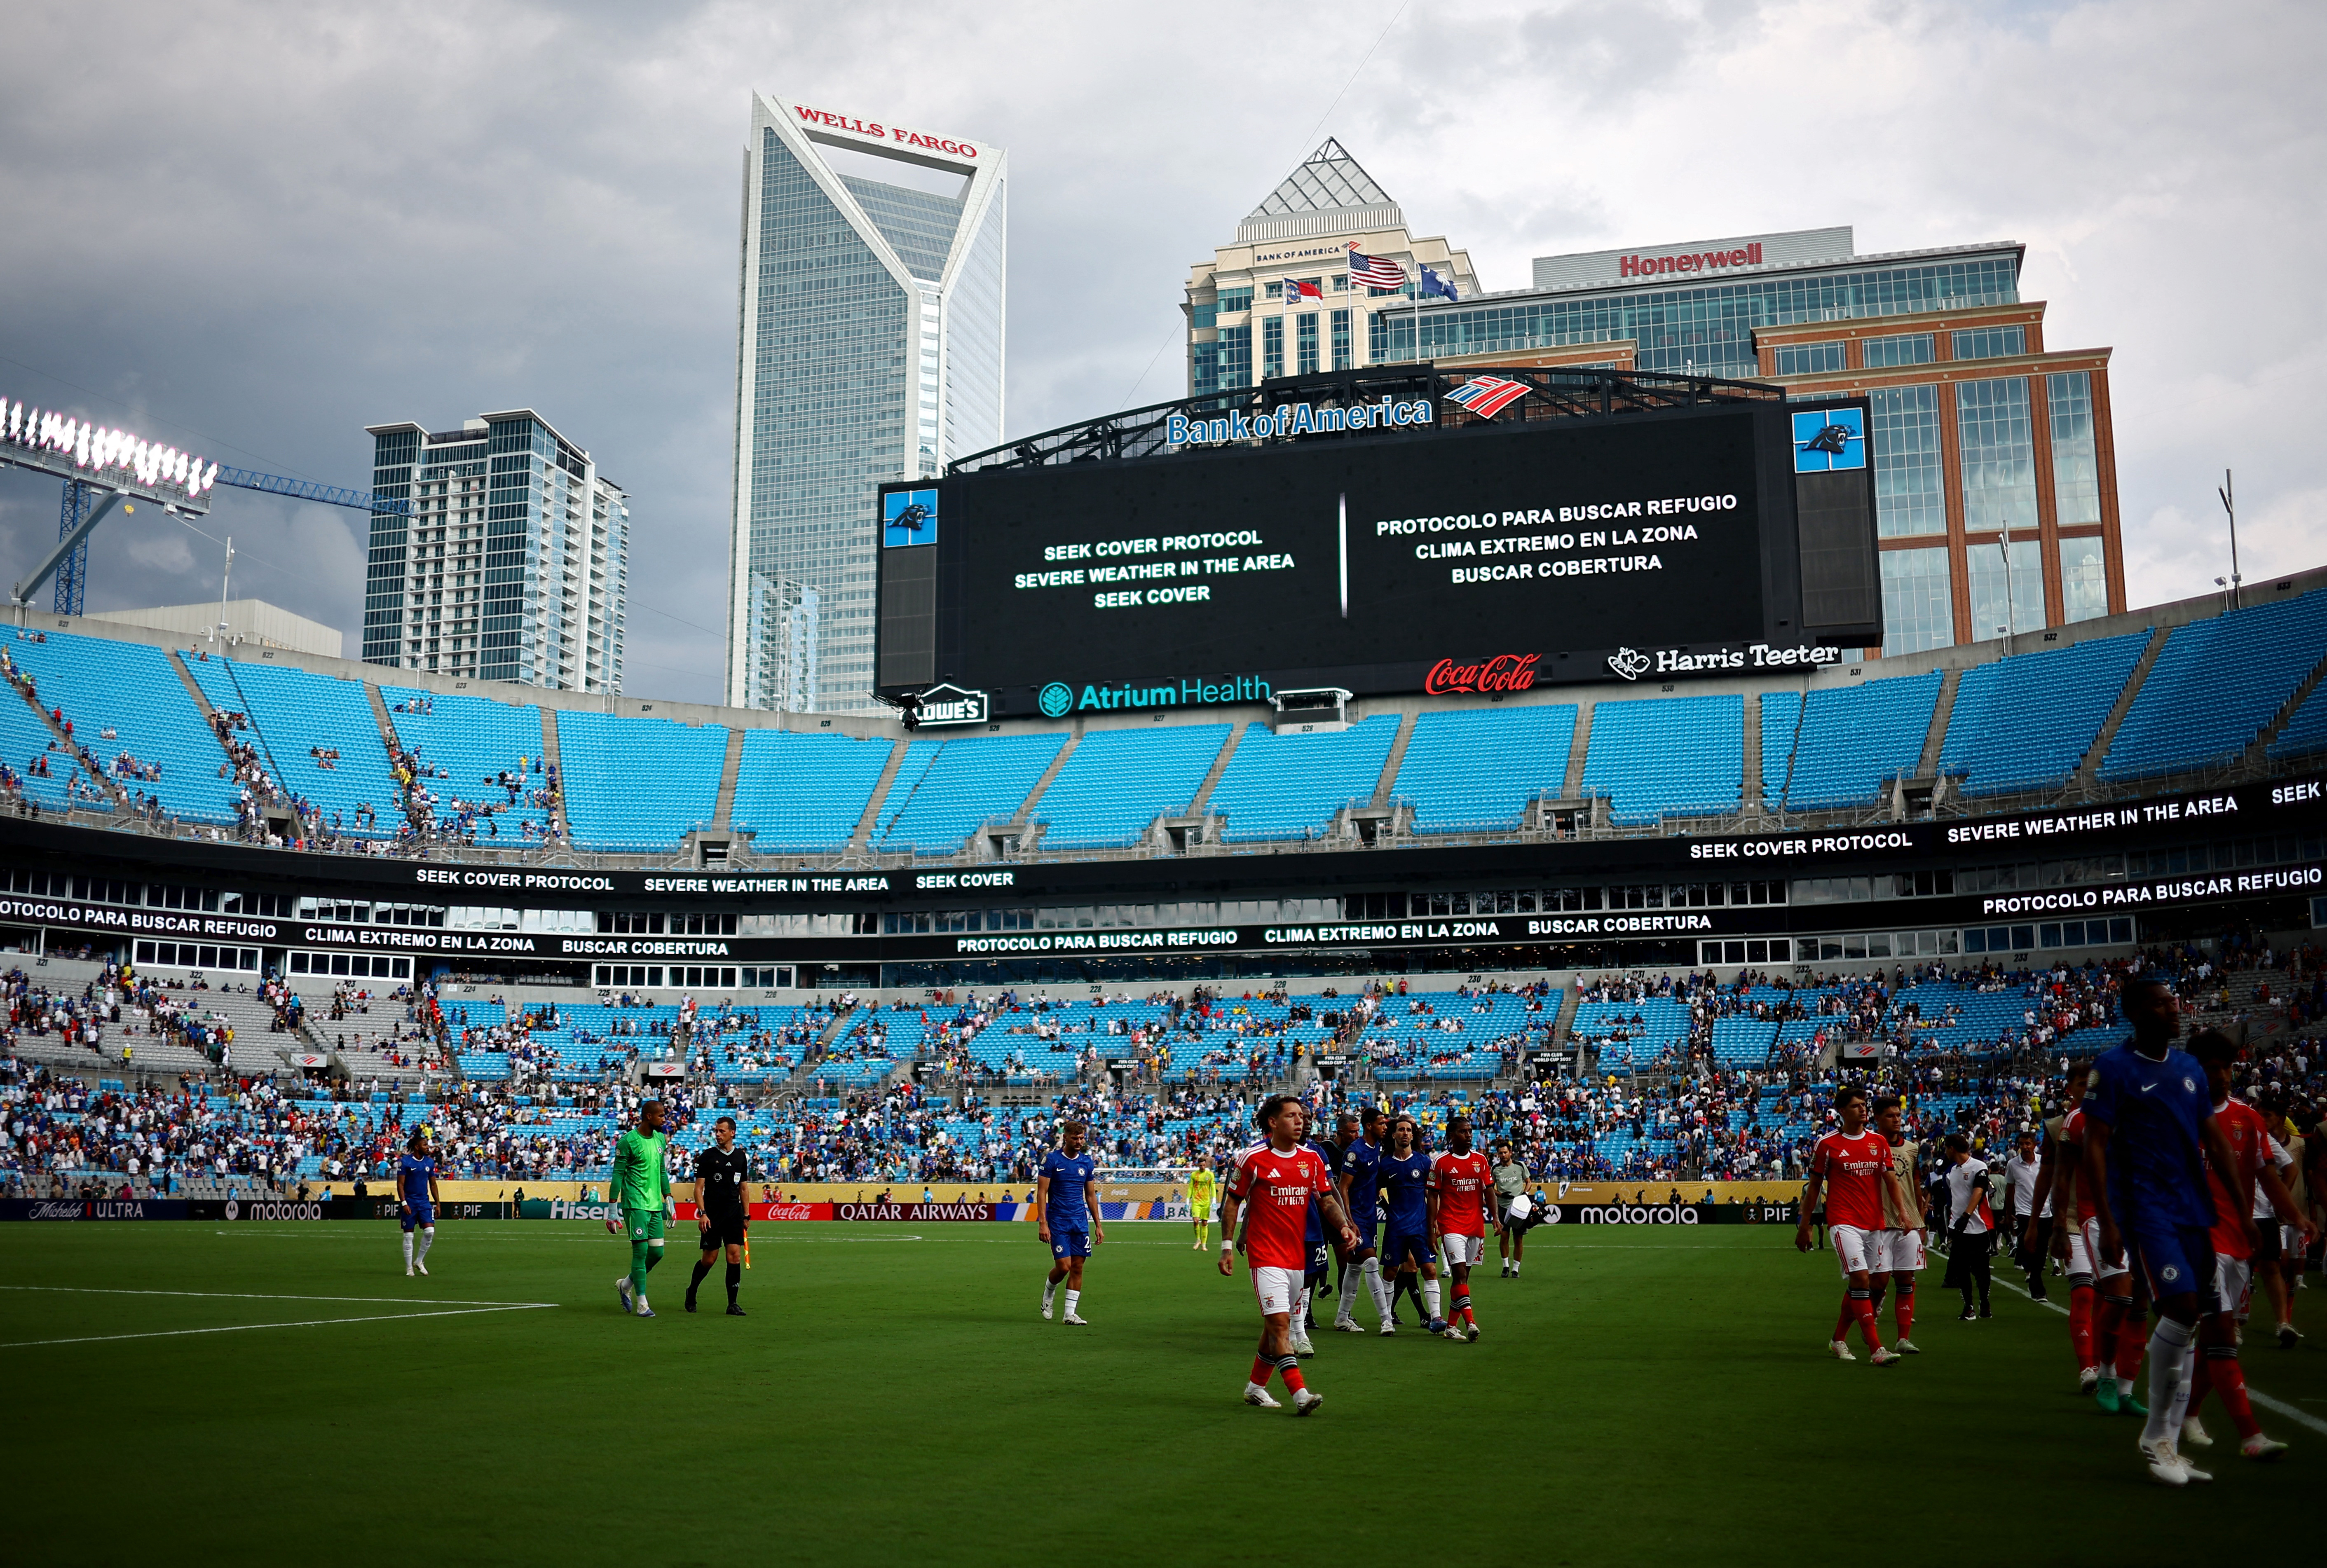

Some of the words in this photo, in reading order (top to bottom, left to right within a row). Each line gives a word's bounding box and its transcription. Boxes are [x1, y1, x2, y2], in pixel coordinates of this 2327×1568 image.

[795, 105, 886, 137] WELLS
[893, 128, 977, 157] FARGO
[1257, 253, 1281, 262] BANK
[1298, 246, 1340, 256] AMERICA
[1620, 242, 1762, 276] Honeywell
[1166, 410, 1250, 445] Bank
[1252, 404, 1289, 438] of
[1291, 395, 1432, 435] America
[1377, 513, 1497, 536] PROTOCOLO
[1502, 508, 1555, 526] PARA
[1560, 502, 1642, 522] BUSCAR
[1647, 494, 1736, 515] REFUGIO
[1045, 543, 1091, 561] SEEK
[1096, 538, 1158, 556] COVER
[1162, 530, 1263, 551] PROTOCOL
[1416, 541, 1476, 559] CLIMA
[1481, 534, 1574, 555] EXTREMO
[1580, 531, 1605, 548] EN
[1612, 529, 1638, 545] LA
[1642, 525, 1698, 543] ZONA
[1015, 570, 1084, 588] SEVERE
[1089, 563, 1176, 582] WEATHER
[1181, 561, 1198, 576] IN
[1203, 557, 1239, 573] THE
[1243, 554, 1295, 571] AREA
[1452, 564, 1533, 583] BUSCAR
[1538, 555, 1662, 577] COBERTURA
[1095, 591, 1142, 608] SEEK
[1147, 586, 1210, 604] COVER
[1656, 648, 1744, 672] Harris
[1749, 644, 1839, 666] Teeter
[1424, 653, 1542, 695] Coca-Cola
[1078, 682, 1176, 710] Atrium
[1181, 674, 1271, 704] Health
[914, 699, 978, 721] LOWE'S
[2272, 782, 2321, 804] SEEK
[1948, 822, 2020, 843] SEVERE
[2025, 812, 2116, 835] WEATHER
[2121, 809, 2138, 825] IN
[2143, 803, 2180, 821] THE
[2185, 796, 2238, 817] AREA
[1691, 843, 1738, 858] SEEK
[1743, 840, 1807, 856] COVER
[1812, 833, 1912, 852] PROTOCOL
[417, 869, 459, 884] SEEK
[464, 872, 521, 887] COVER
[525, 875, 614, 890] PROTOCOL
[644, 878, 708, 892] SEVERE
[712, 879, 788, 892] WEATHER
[792, 879, 807, 892] IN
[811, 879, 841, 891] THE
[845, 878, 888, 891] AREA
[916, 875, 956, 889] SEEK
[960, 873, 1013, 887] COVER
[1984, 892, 2097, 914] PROTOCOLO
[2103, 887, 2152, 905] PARA
[2156, 878, 2233, 899] BUSCAR
[2238, 868, 2322, 891] REFUGIO
[85, 909, 127, 926] PARA
[131, 914, 199, 932] BUSCAR
[205, 920, 276, 938] REFUGIO
[1265, 929, 1315, 943] CLIMA
[1319, 926, 1397, 941] EXTREMO
[1401, 925, 1423, 938] EN
[1428, 924, 1450, 937] LA
[1453, 922, 1499, 936] ZONA
[1529, 919, 1599, 934] BUSCAR
[1604, 915, 1711, 931] COBERTURA
[305, 928, 356, 943] CLIMA
[360, 931, 436, 947] EXTREMO
[441, 936, 462, 948] EN
[466, 937, 487, 949] LA
[490, 938, 534, 951] ZONA
[562, 940, 627, 954] BUSCAR
[631, 942, 728, 955] COBERTURA
[958, 937, 1051, 952] PROTOCOLO
[1055, 936, 1096, 949] PARA
[1099, 934, 1164, 948] BUSCAR
[1168, 931, 1237, 945] REFUGIO
[36, 958, 48, 967] 321
[2013, 953, 2029, 962] 233
[1795, 965, 1809, 973] 232
[1843, 1161, 1878, 1171] Emirates
[1270, 1185, 1308, 1196] Emirates
[1278, 1197, 1288, 1205] FLY
[29, 1202, 83, 1219] Michelob
[97, 1203, 143, 1218] ULTRA
[250, 1200, 321, 1220] motorola
[384, 1204, 399, 1217] PIF
[464, 1205, 482, 1217] PIF
[768, 1204, 813, 1219] Coca-Cola
[841, 1204, 902, 1221] QATAR
[910, 1205, 987, 1219] AIRWAYS
[1581, 1203, 1698, 1224] motorola
[1764, 1208, 1791, 1221] PIF
[1315, 1244, 1327, 1262] 25
